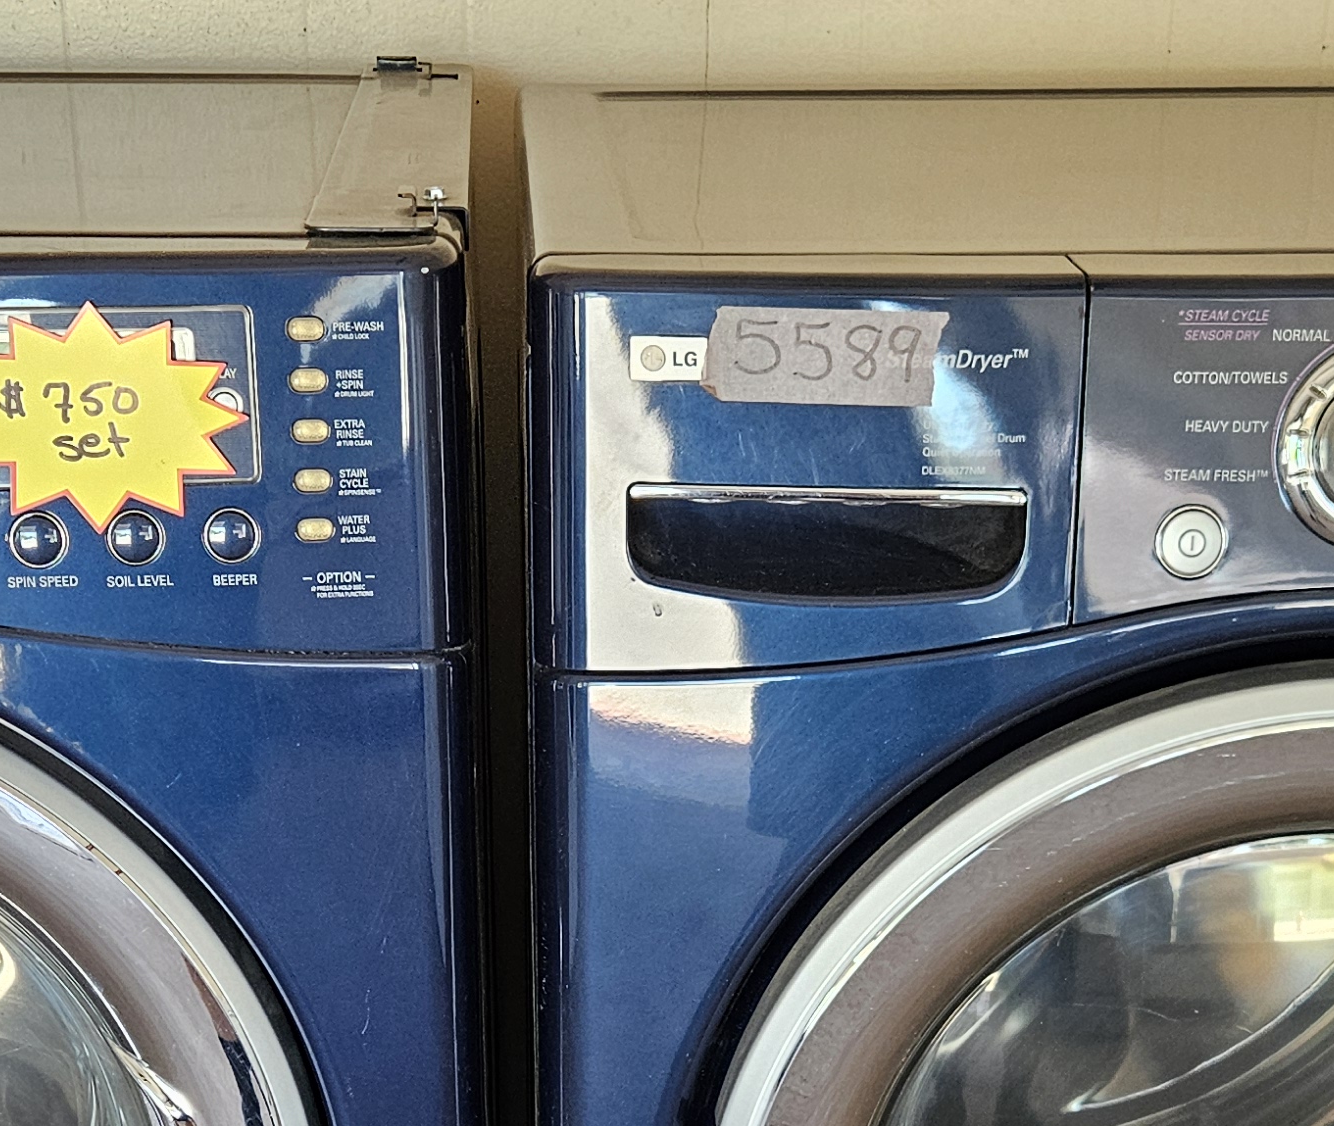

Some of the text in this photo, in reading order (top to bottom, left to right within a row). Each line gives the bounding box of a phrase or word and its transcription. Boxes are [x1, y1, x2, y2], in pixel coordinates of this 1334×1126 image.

[1231, 309, 1270, 322] CYCLE
[332, 321, 384, 332] PRE-WASH
[1184, 329, 1261, 341] SENSOR DRY
[1272, 328, 1331, 342] NORMAL
[734, 319, 922, 383] 5589
[672, 351, 698, 367] LG
[335, 369, 364, 380] RINSE
[1173, 371, 1288, 385] COTTON/TOWELS
[334, 419, 365, 429] EXTRA
[1185, 420, 1269, 433] HEAVY DUTY
[336, 429, 364, 439] RINSE
[997, 433, 1026, 443] Drum
[52, 421, 131, 462] set
[339, 468, 367, 478] STAIN
[1164, 469, 1210, 481] STEAM
[339, 478, 369, 488] CYCLE
[338, 515, 370, 525] WATER
[342, 525, 366, 535] PLUS
[7, 575, 79, 589] SPIN SPEED
[106, 575, 174, 588] SOIL LEVEL
[212, 573, 258, 586] BEEPER
[316, 571, 362, 583] OPTION
